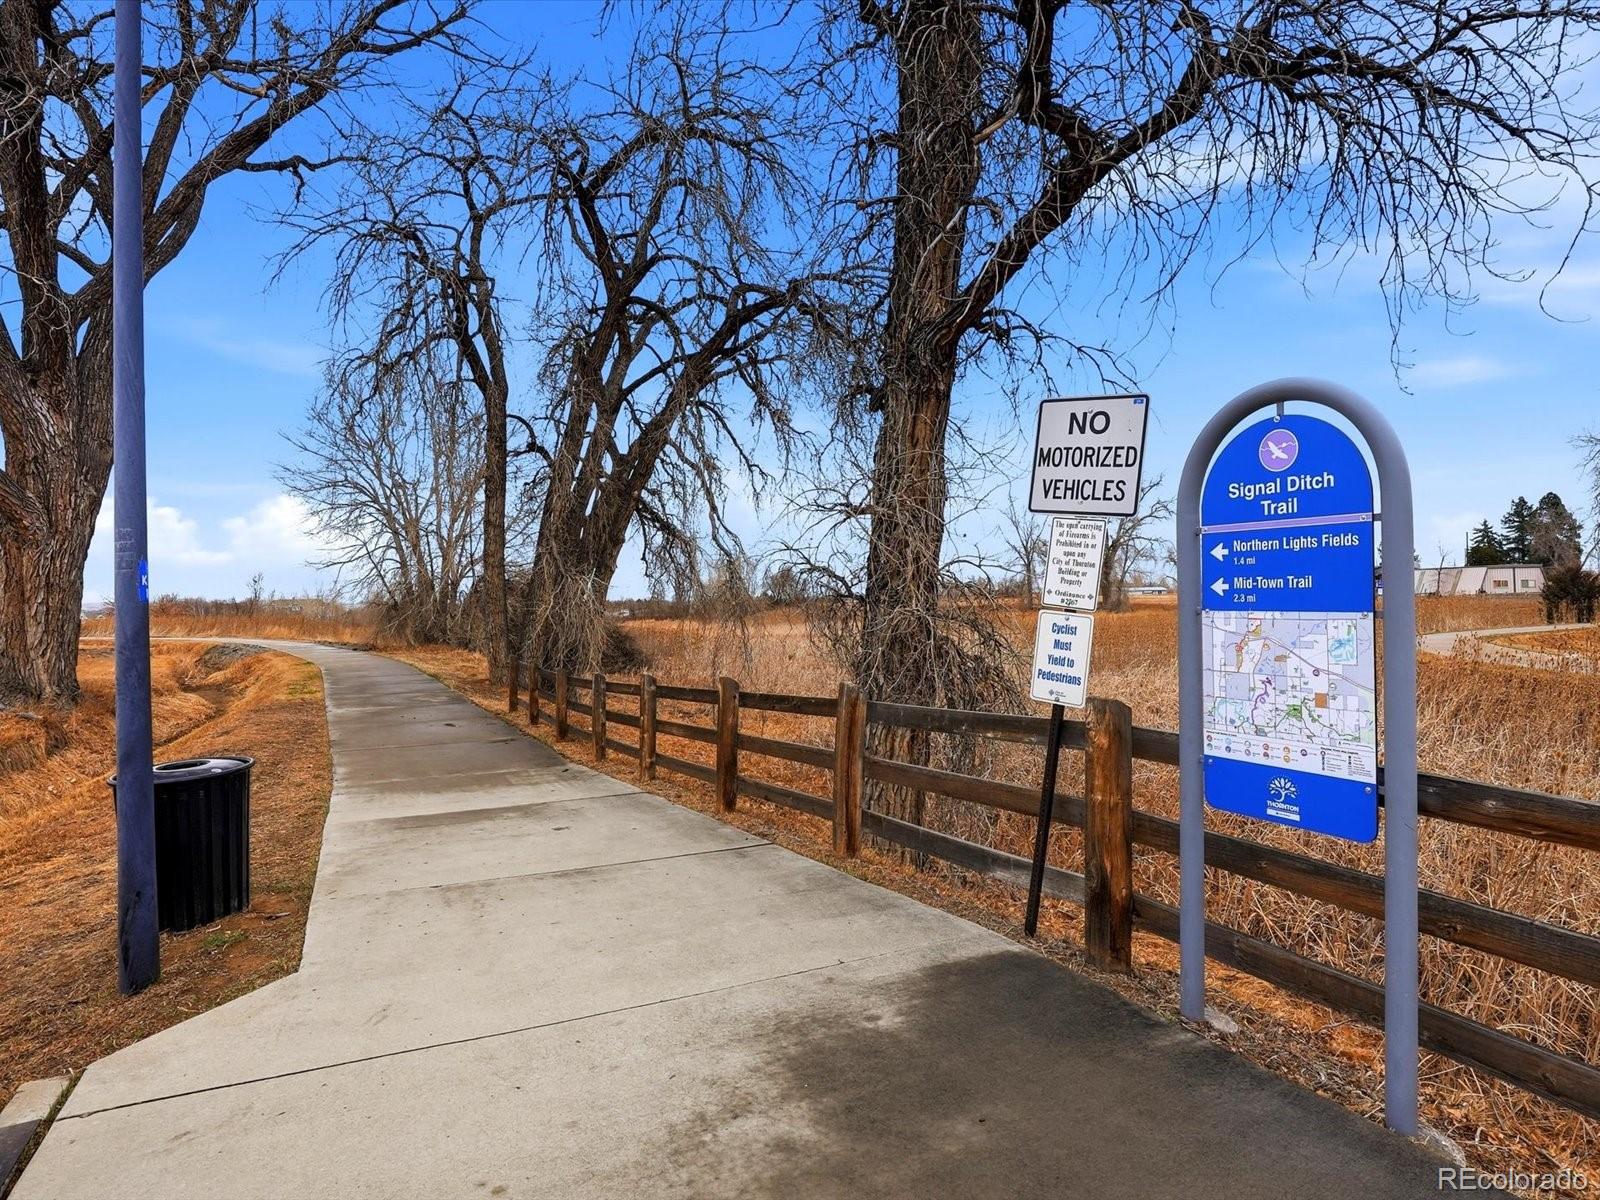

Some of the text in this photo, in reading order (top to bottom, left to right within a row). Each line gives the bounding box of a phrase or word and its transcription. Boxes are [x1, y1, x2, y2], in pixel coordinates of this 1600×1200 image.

[1068, 410, 1111, 435] NO
[1037, 446, 1138, 468] MOTORIZED
[1042, 479, 1127, 501] VEHICLES
[1228, 471, 1335, 500] Signal Ditch
[1260, 497, 1298, 516] Trail
[1066, 521, 1079, 530] open
[1080, 522, 1103, 531] carrying
[1066, 530, 1090, 539] Firearms
[1056, 540, 1082, 548] Prohibited
[1233, 533, 1360, 552] Northern Lights Fields
[1052, 557, 1063, 566] City
[1072, 558, 1096, 568] Thornton
[1233, 556, 1256, 565] 1.4 mi
[1058, 568, 1080, 577] Building
[1060, 576, 1082, 587] Property
[1233, 575, 1313, 590] Mid-Town Trail
[1055, 590, 1085, 599] Ordinance
[1233, 593, 1256, 603] 2.3 mi
[1051, 623, 1077, 635] Cyclist
[1053, 639, 1072, 651] Must
[1047, 654, 1075, 668] Yield to
[1037, 668, 1082, 686] Pedestrians
[1267, 800, 1299, 812] THORNTON
